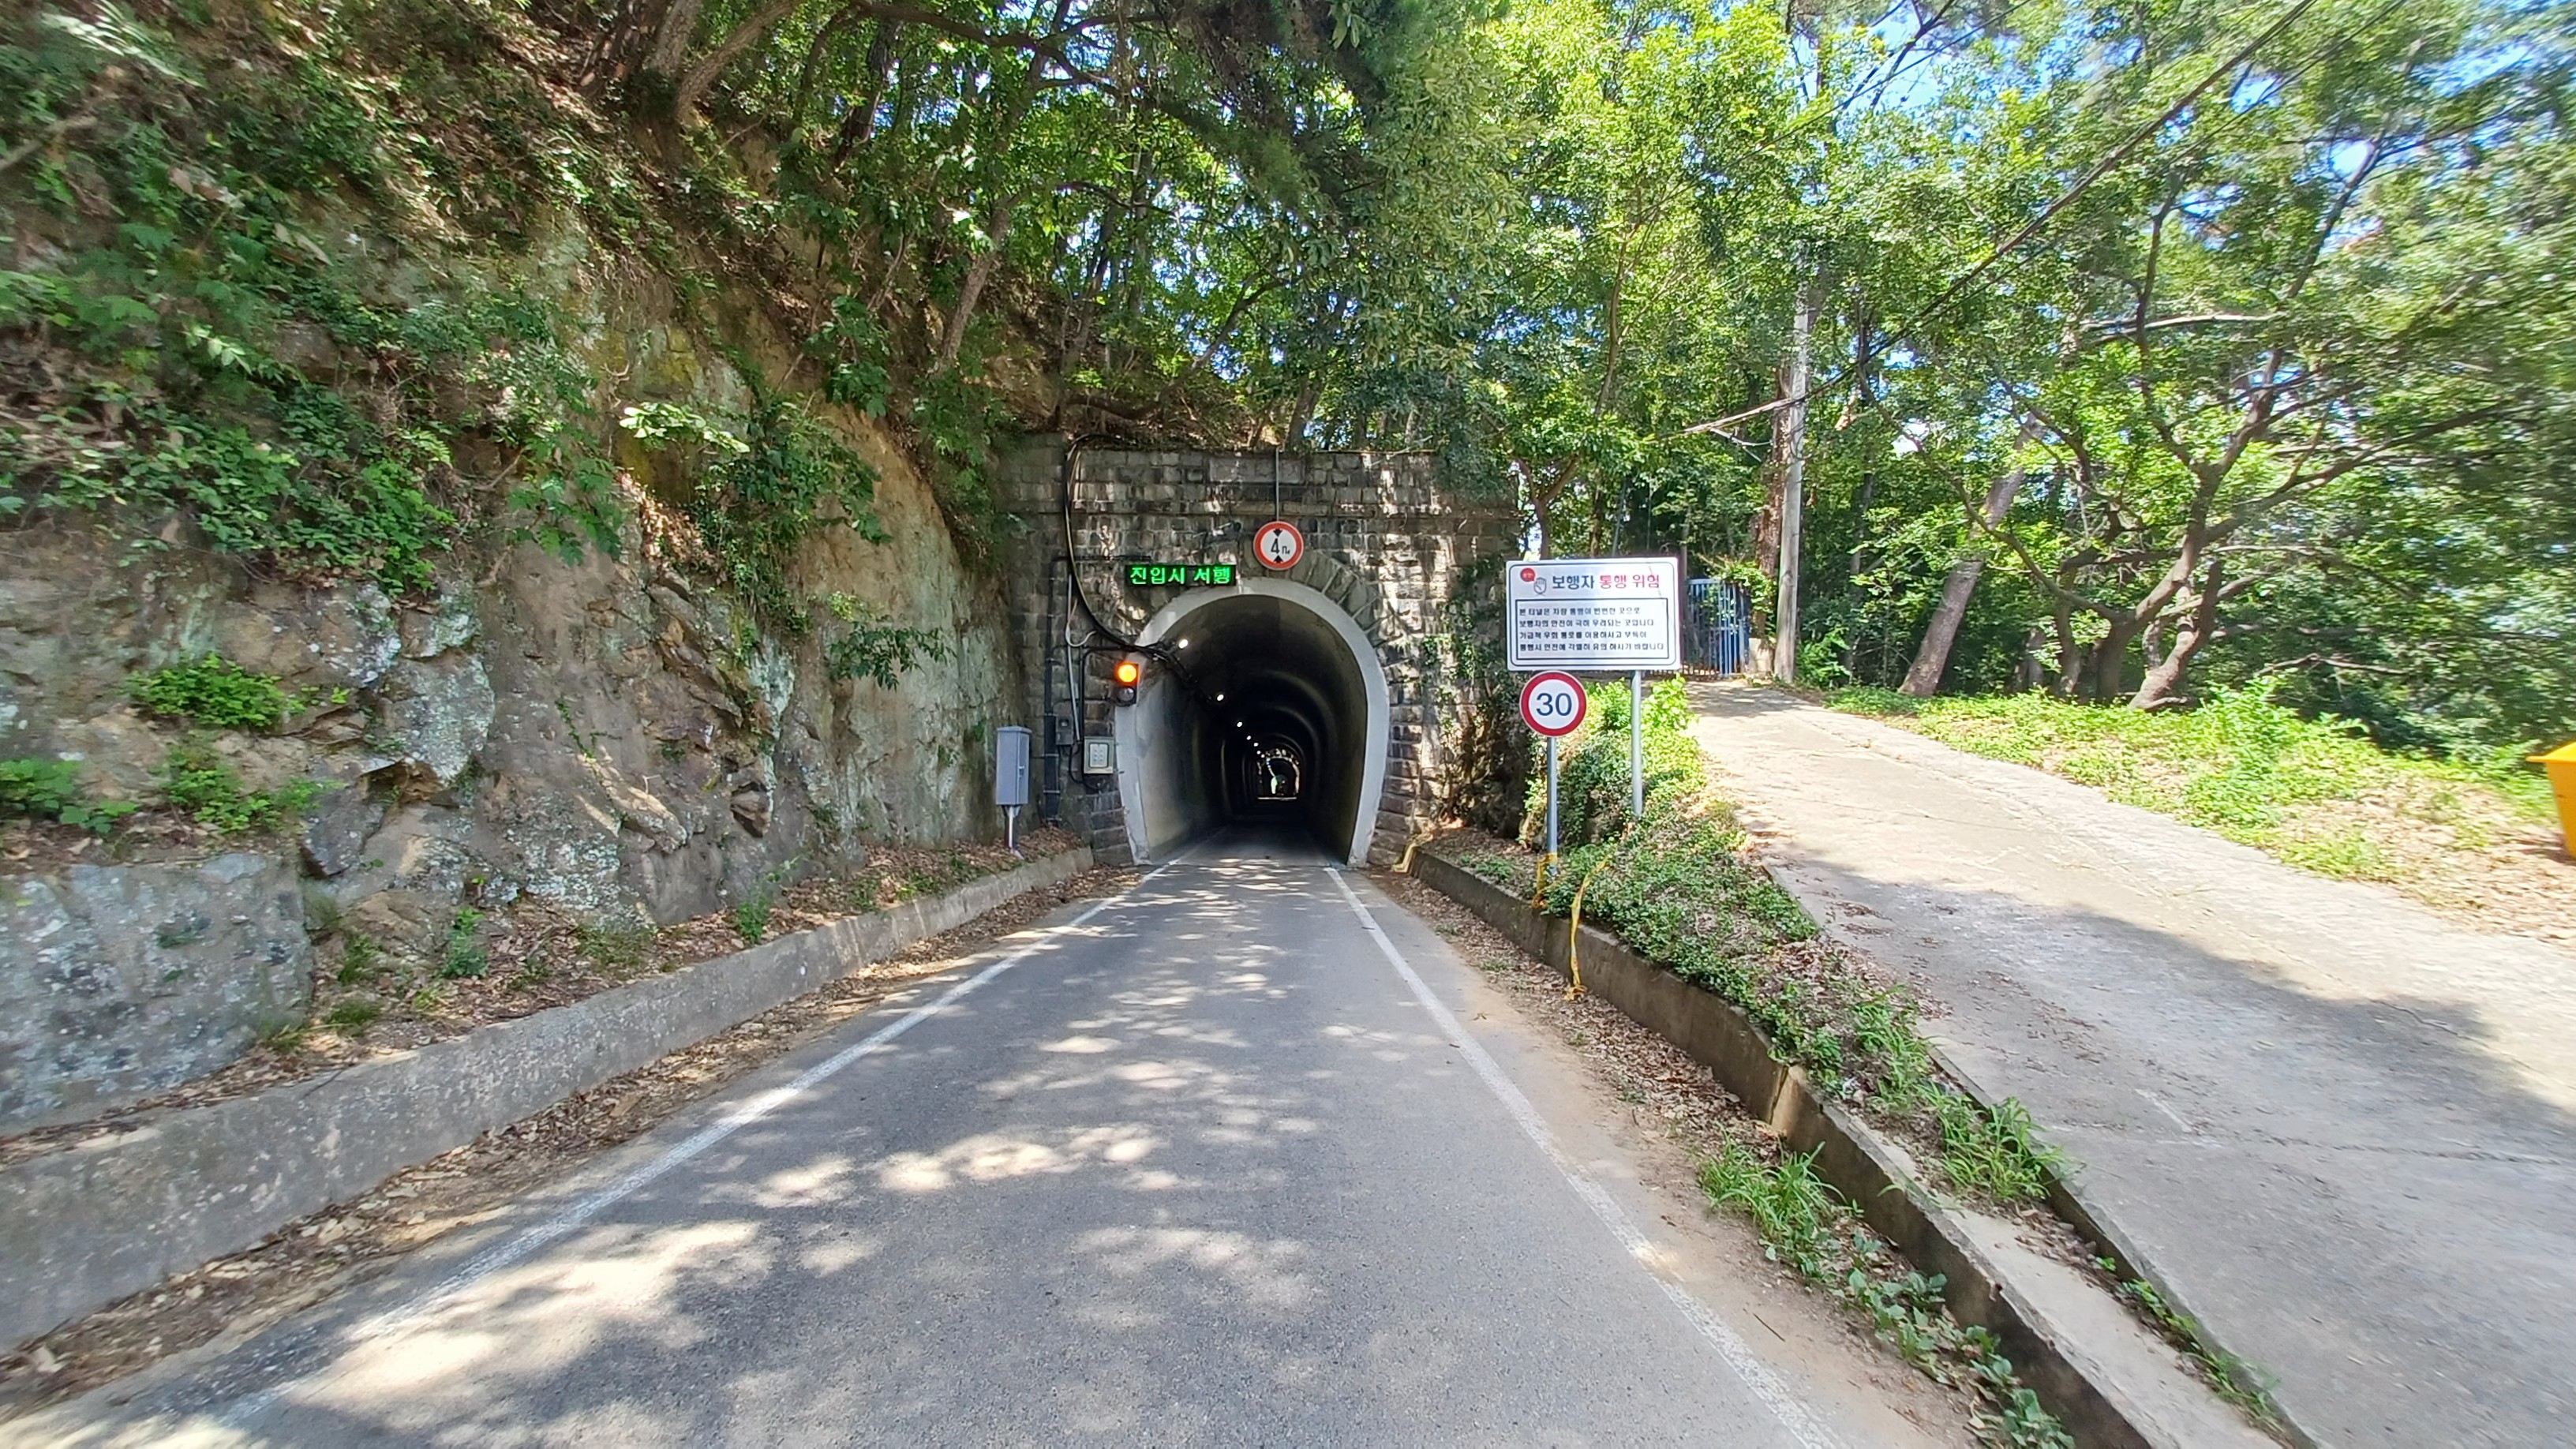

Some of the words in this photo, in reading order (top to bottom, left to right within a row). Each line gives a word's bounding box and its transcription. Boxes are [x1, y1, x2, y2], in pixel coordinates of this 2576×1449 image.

[1130, 567, 1185, 585] 진입시
[1193, 567, 1230, 585] 서행
[1552, 575, 1595, 589] 보행자
[1599, 575, 1626, 589] 통행
[1632, 574, 1660, 588] 위험
[1536, 693, 1572, 716] 30
